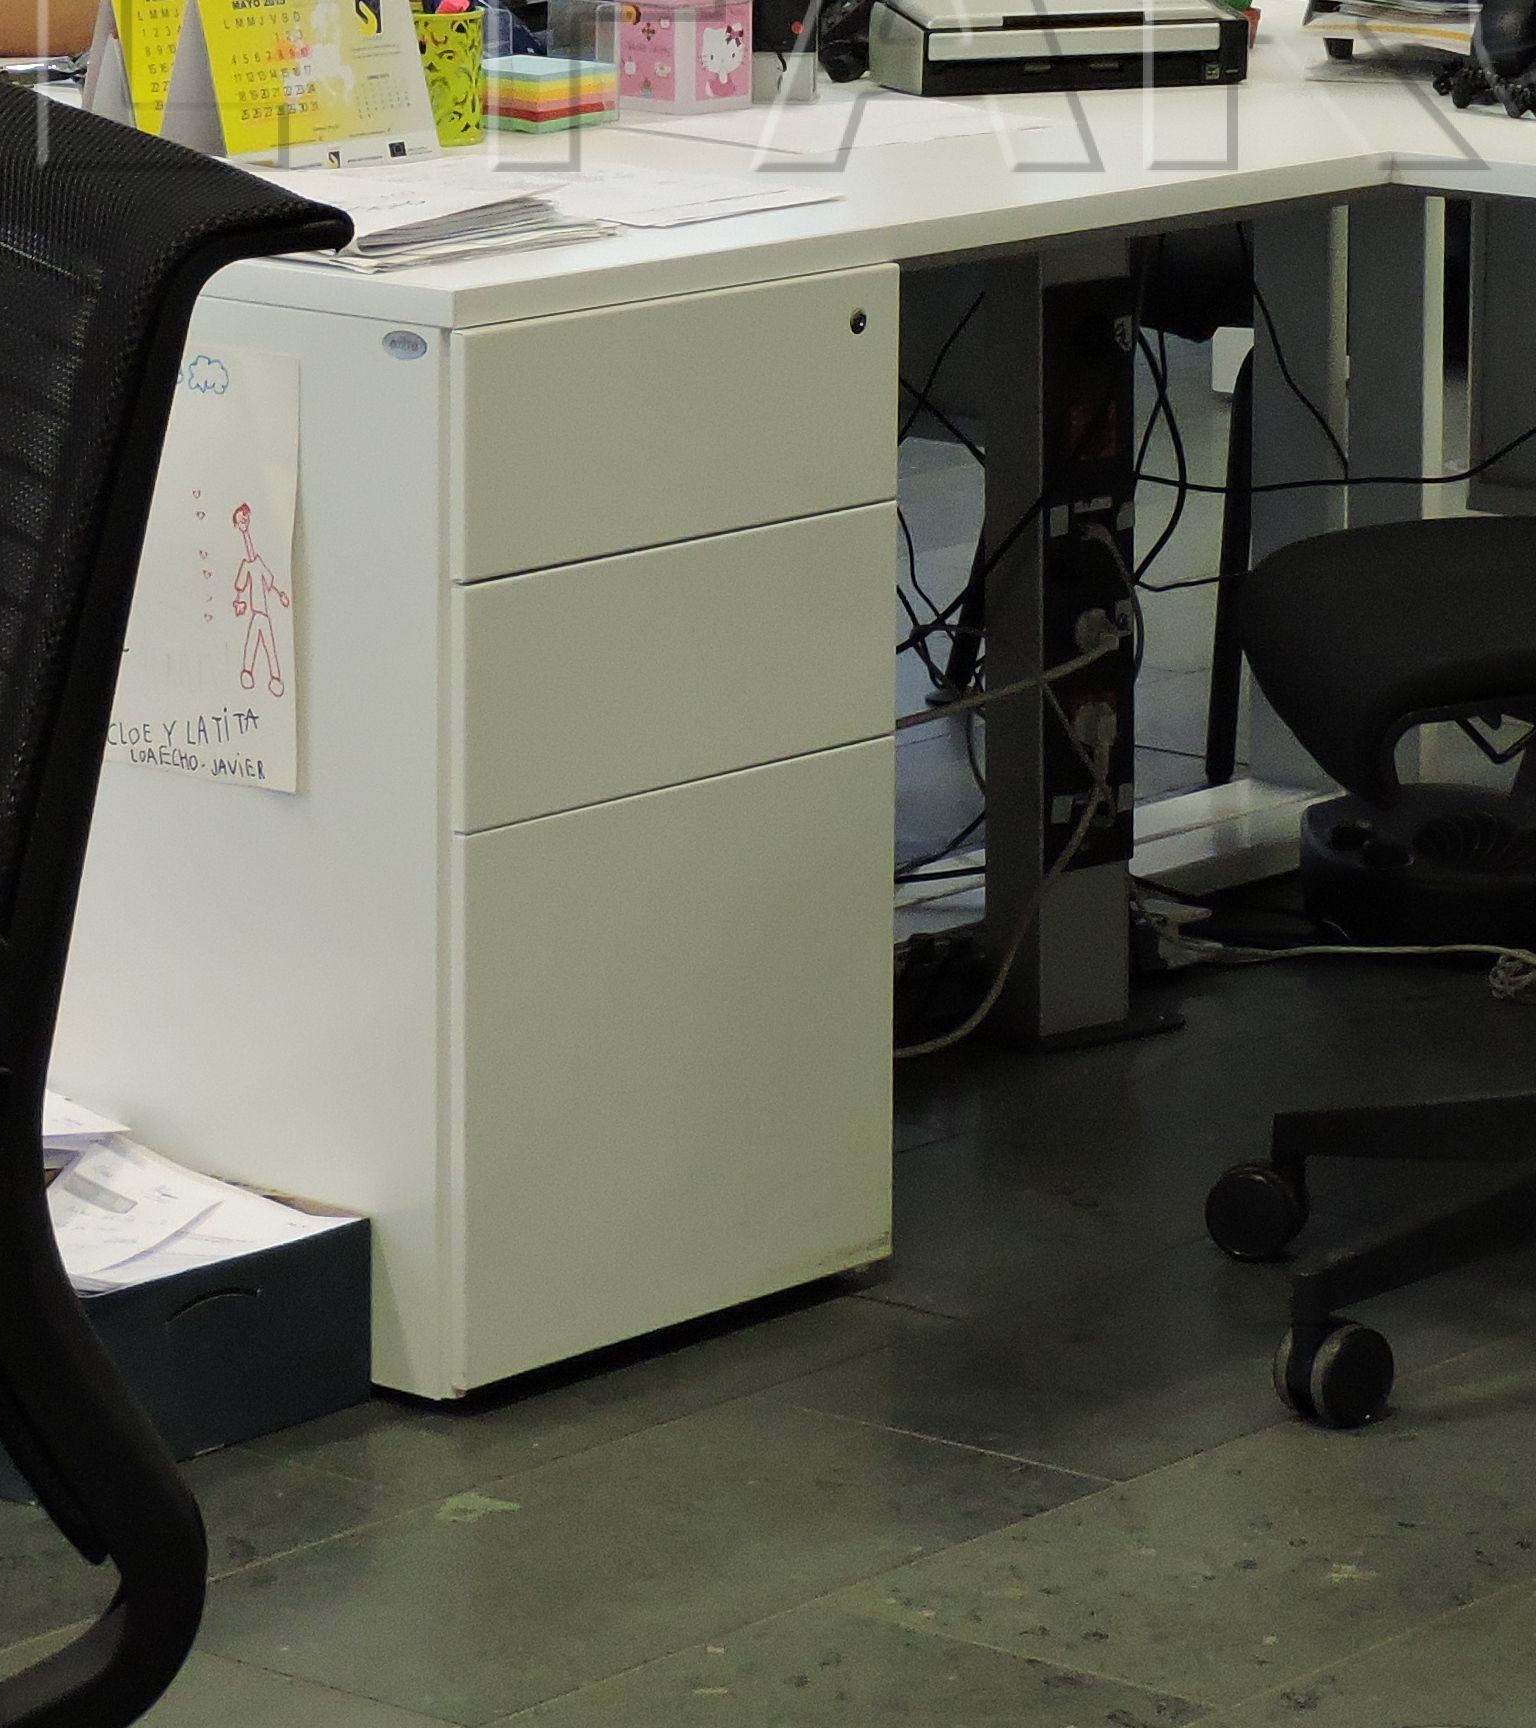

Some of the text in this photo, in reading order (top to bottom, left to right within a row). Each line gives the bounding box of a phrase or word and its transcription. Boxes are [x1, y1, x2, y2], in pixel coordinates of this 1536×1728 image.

[149, 10, 157, 19] M
[161, 9, 169, 18] M
[236, 18, 243, 27] M
[247, 16, 255, 26] M
[269, 14, 277, 24] V
[282, 13, 289, 22] S
[294, 12, 301, 22] D
[244, 54, 249, 64] 5
[255, 52, 260, 62] 6
[234, 74, 241, 83] 11
[246, 72, 254, 82] 12
[304, 65, 311, 75] 17
[261, 89, 269, 98] 20
[163, 721, 176, 746] Y
